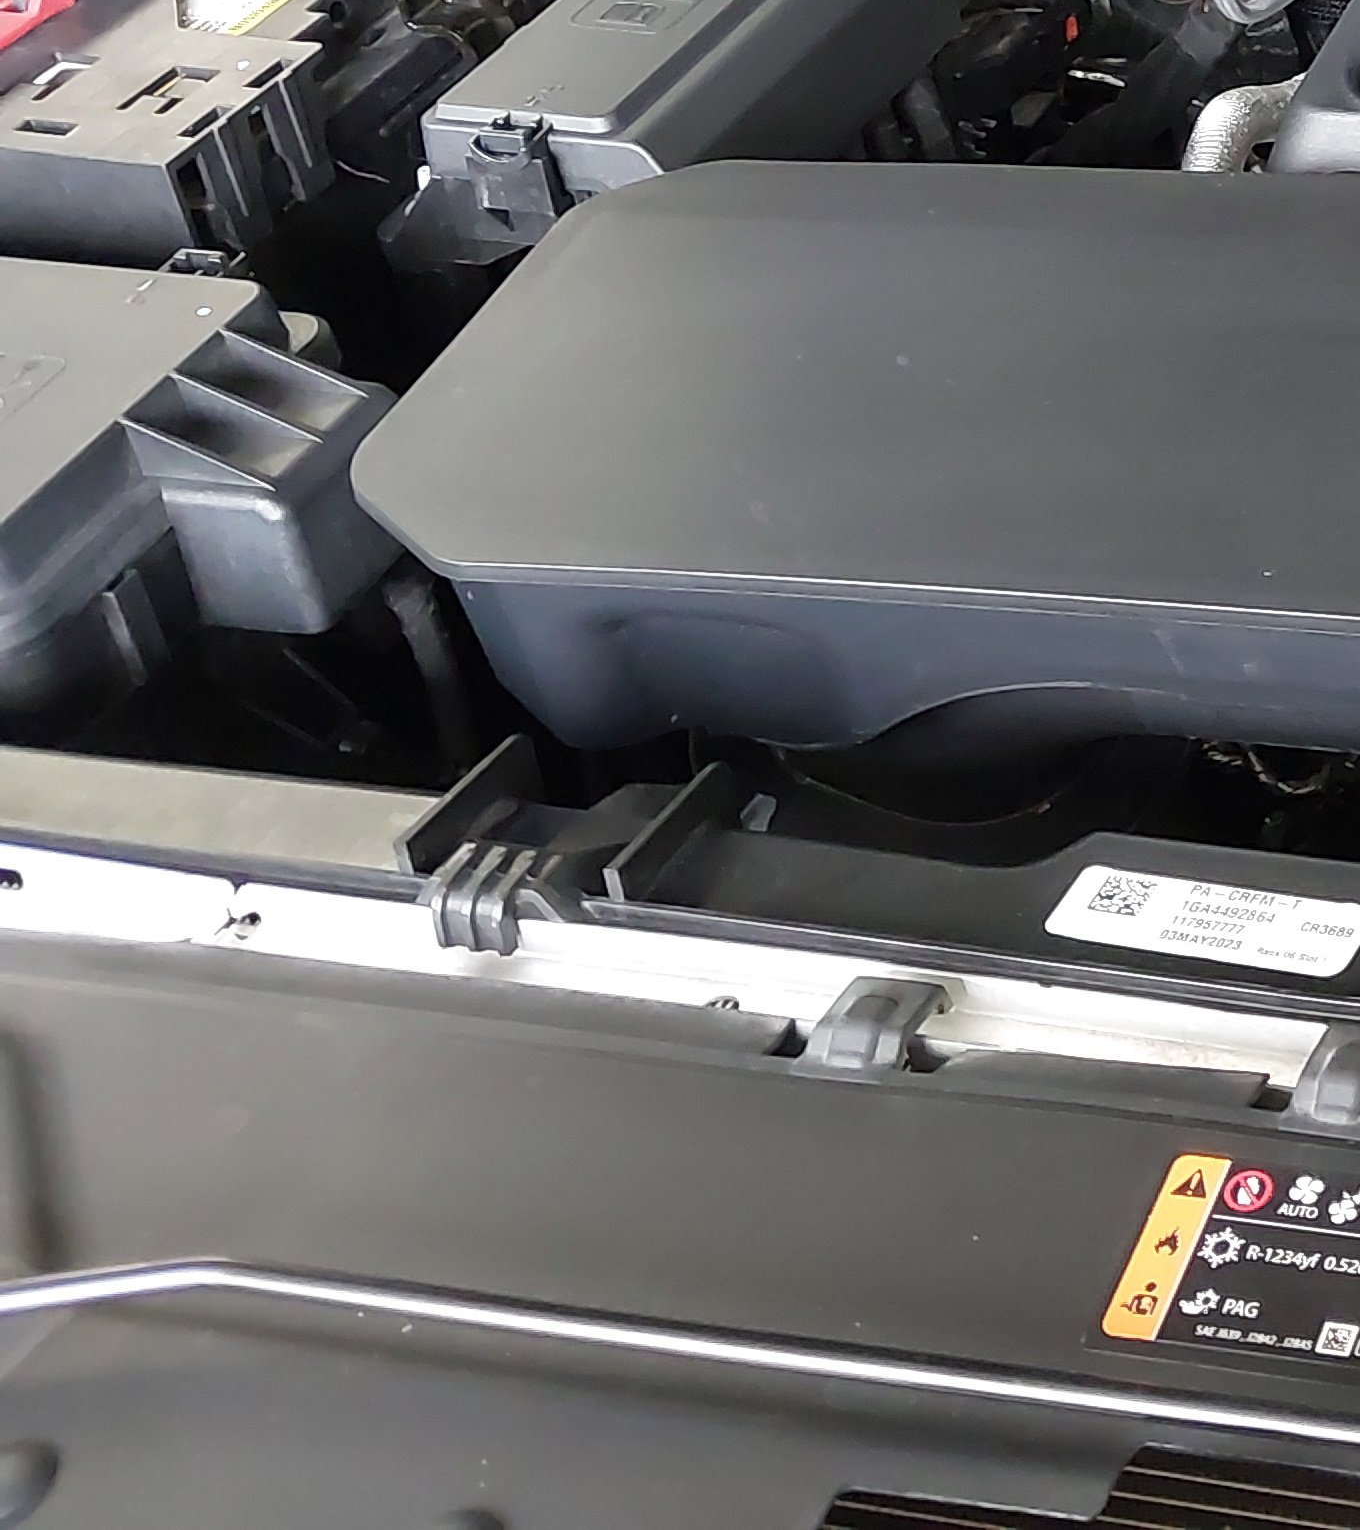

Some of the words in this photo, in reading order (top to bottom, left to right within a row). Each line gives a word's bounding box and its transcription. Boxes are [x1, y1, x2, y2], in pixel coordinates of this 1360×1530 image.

[1277, 1203, 1319, 1219] AUTO
[1246, 1245, 1322, 1271] R-1234yf
[1222, 1298, 1261, 1319] PAG
